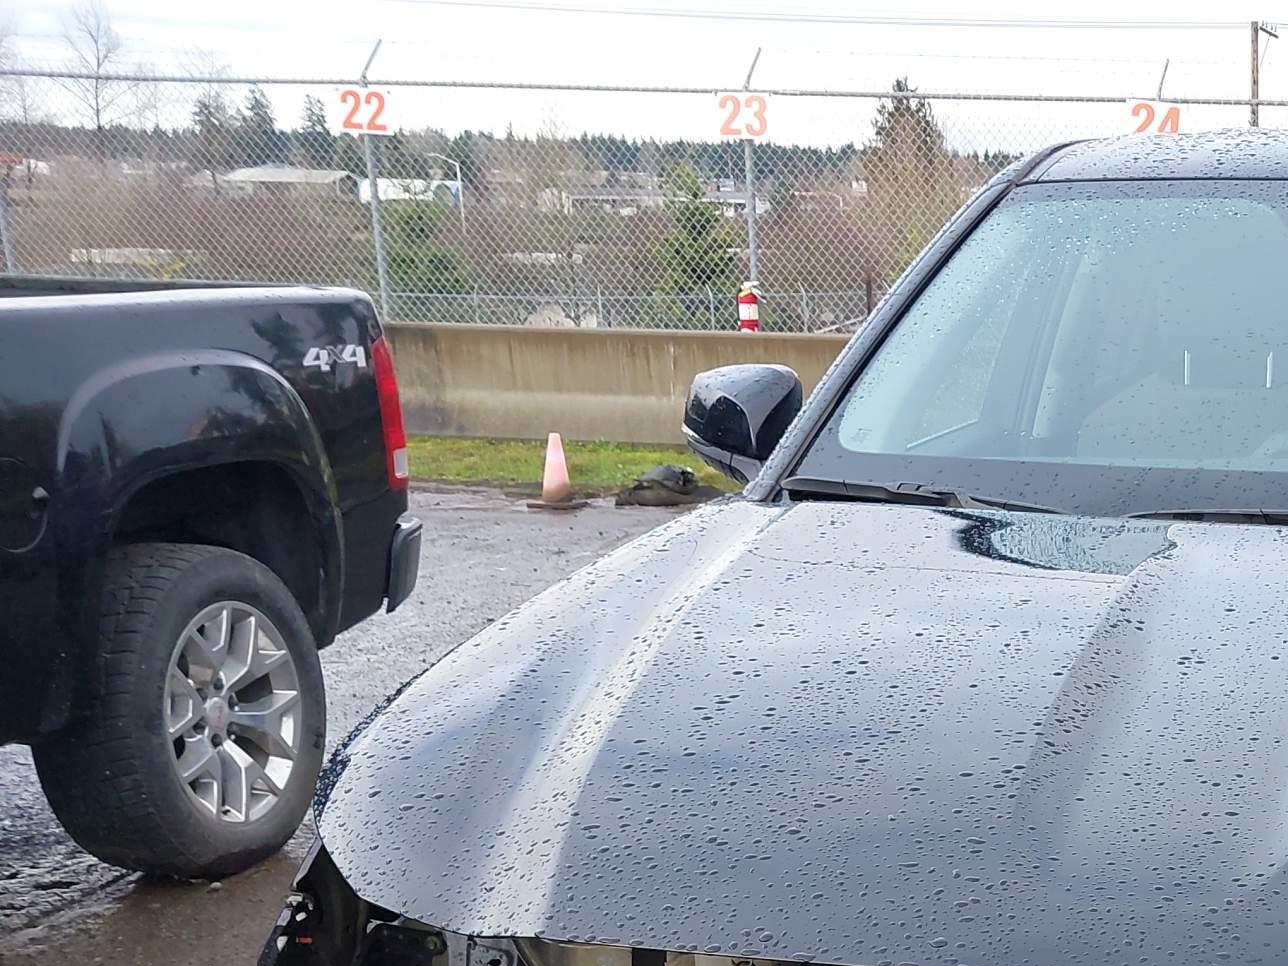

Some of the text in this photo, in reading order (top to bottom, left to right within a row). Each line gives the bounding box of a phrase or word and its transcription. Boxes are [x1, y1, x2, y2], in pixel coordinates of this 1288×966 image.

[341, 90, 387, 131] 22
[719, 94, 767, 136] 23
[1131, 103, 1180, 134] 24
